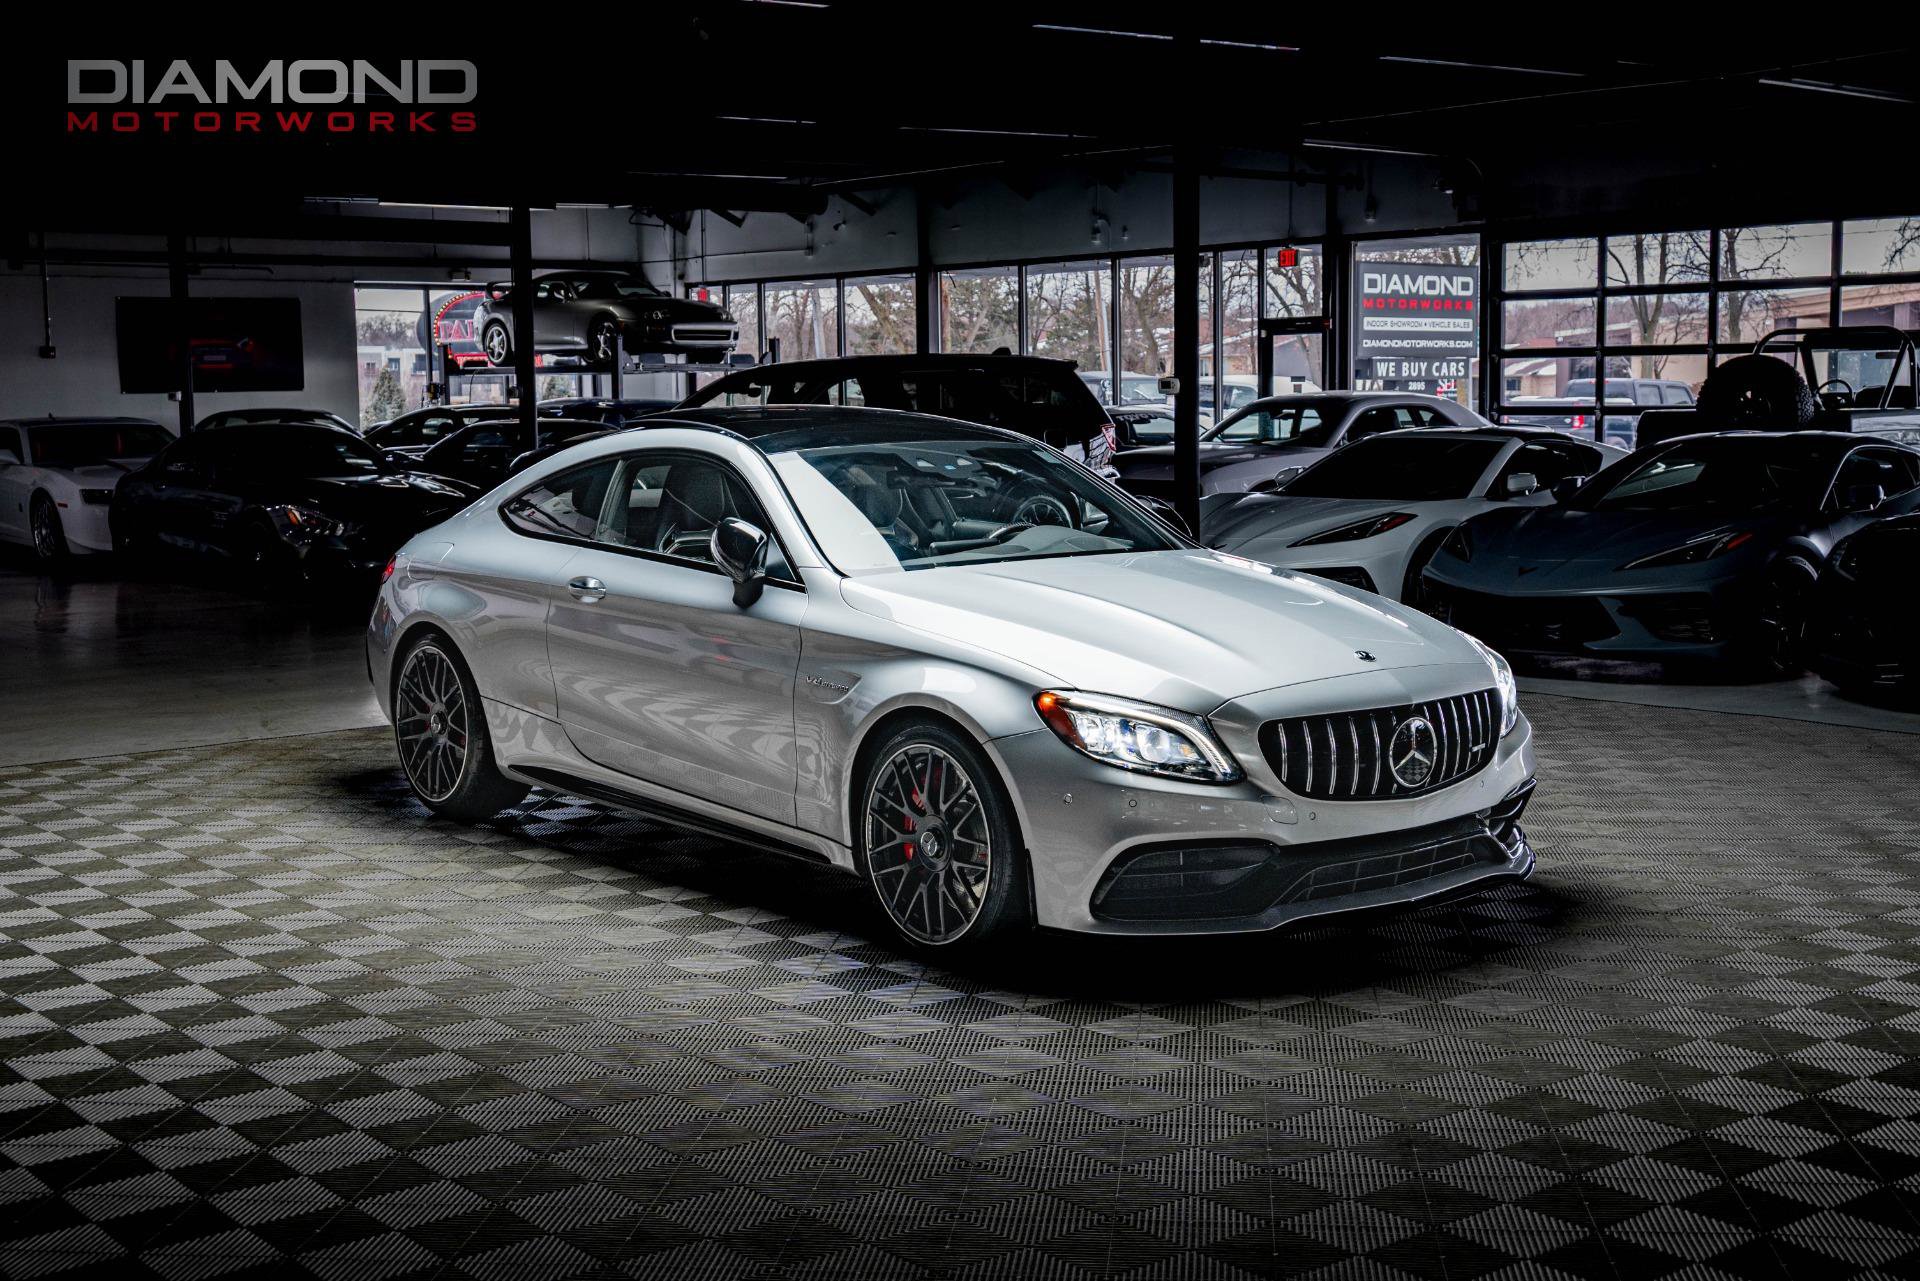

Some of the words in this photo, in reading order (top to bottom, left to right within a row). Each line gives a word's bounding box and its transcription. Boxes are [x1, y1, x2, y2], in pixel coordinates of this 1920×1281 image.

[1363, 273, 1473, 296] DIAMOND
[1362, 298, 1473, 311] MOTORWORKS
[1390, 320, 1423, 328] SHOWROOM
[1429, 321, 1451, 329] VEHICLE
[1453, 321, 1470, 329] SALES
[1362, 339, 1473, 348] DIAMONDMOTORWORKS.COM
[1377, 361, 1396, 377] WE
[1402, 361, 1427, 377] BUY
[1432, 361, 1465, 377] CARS
